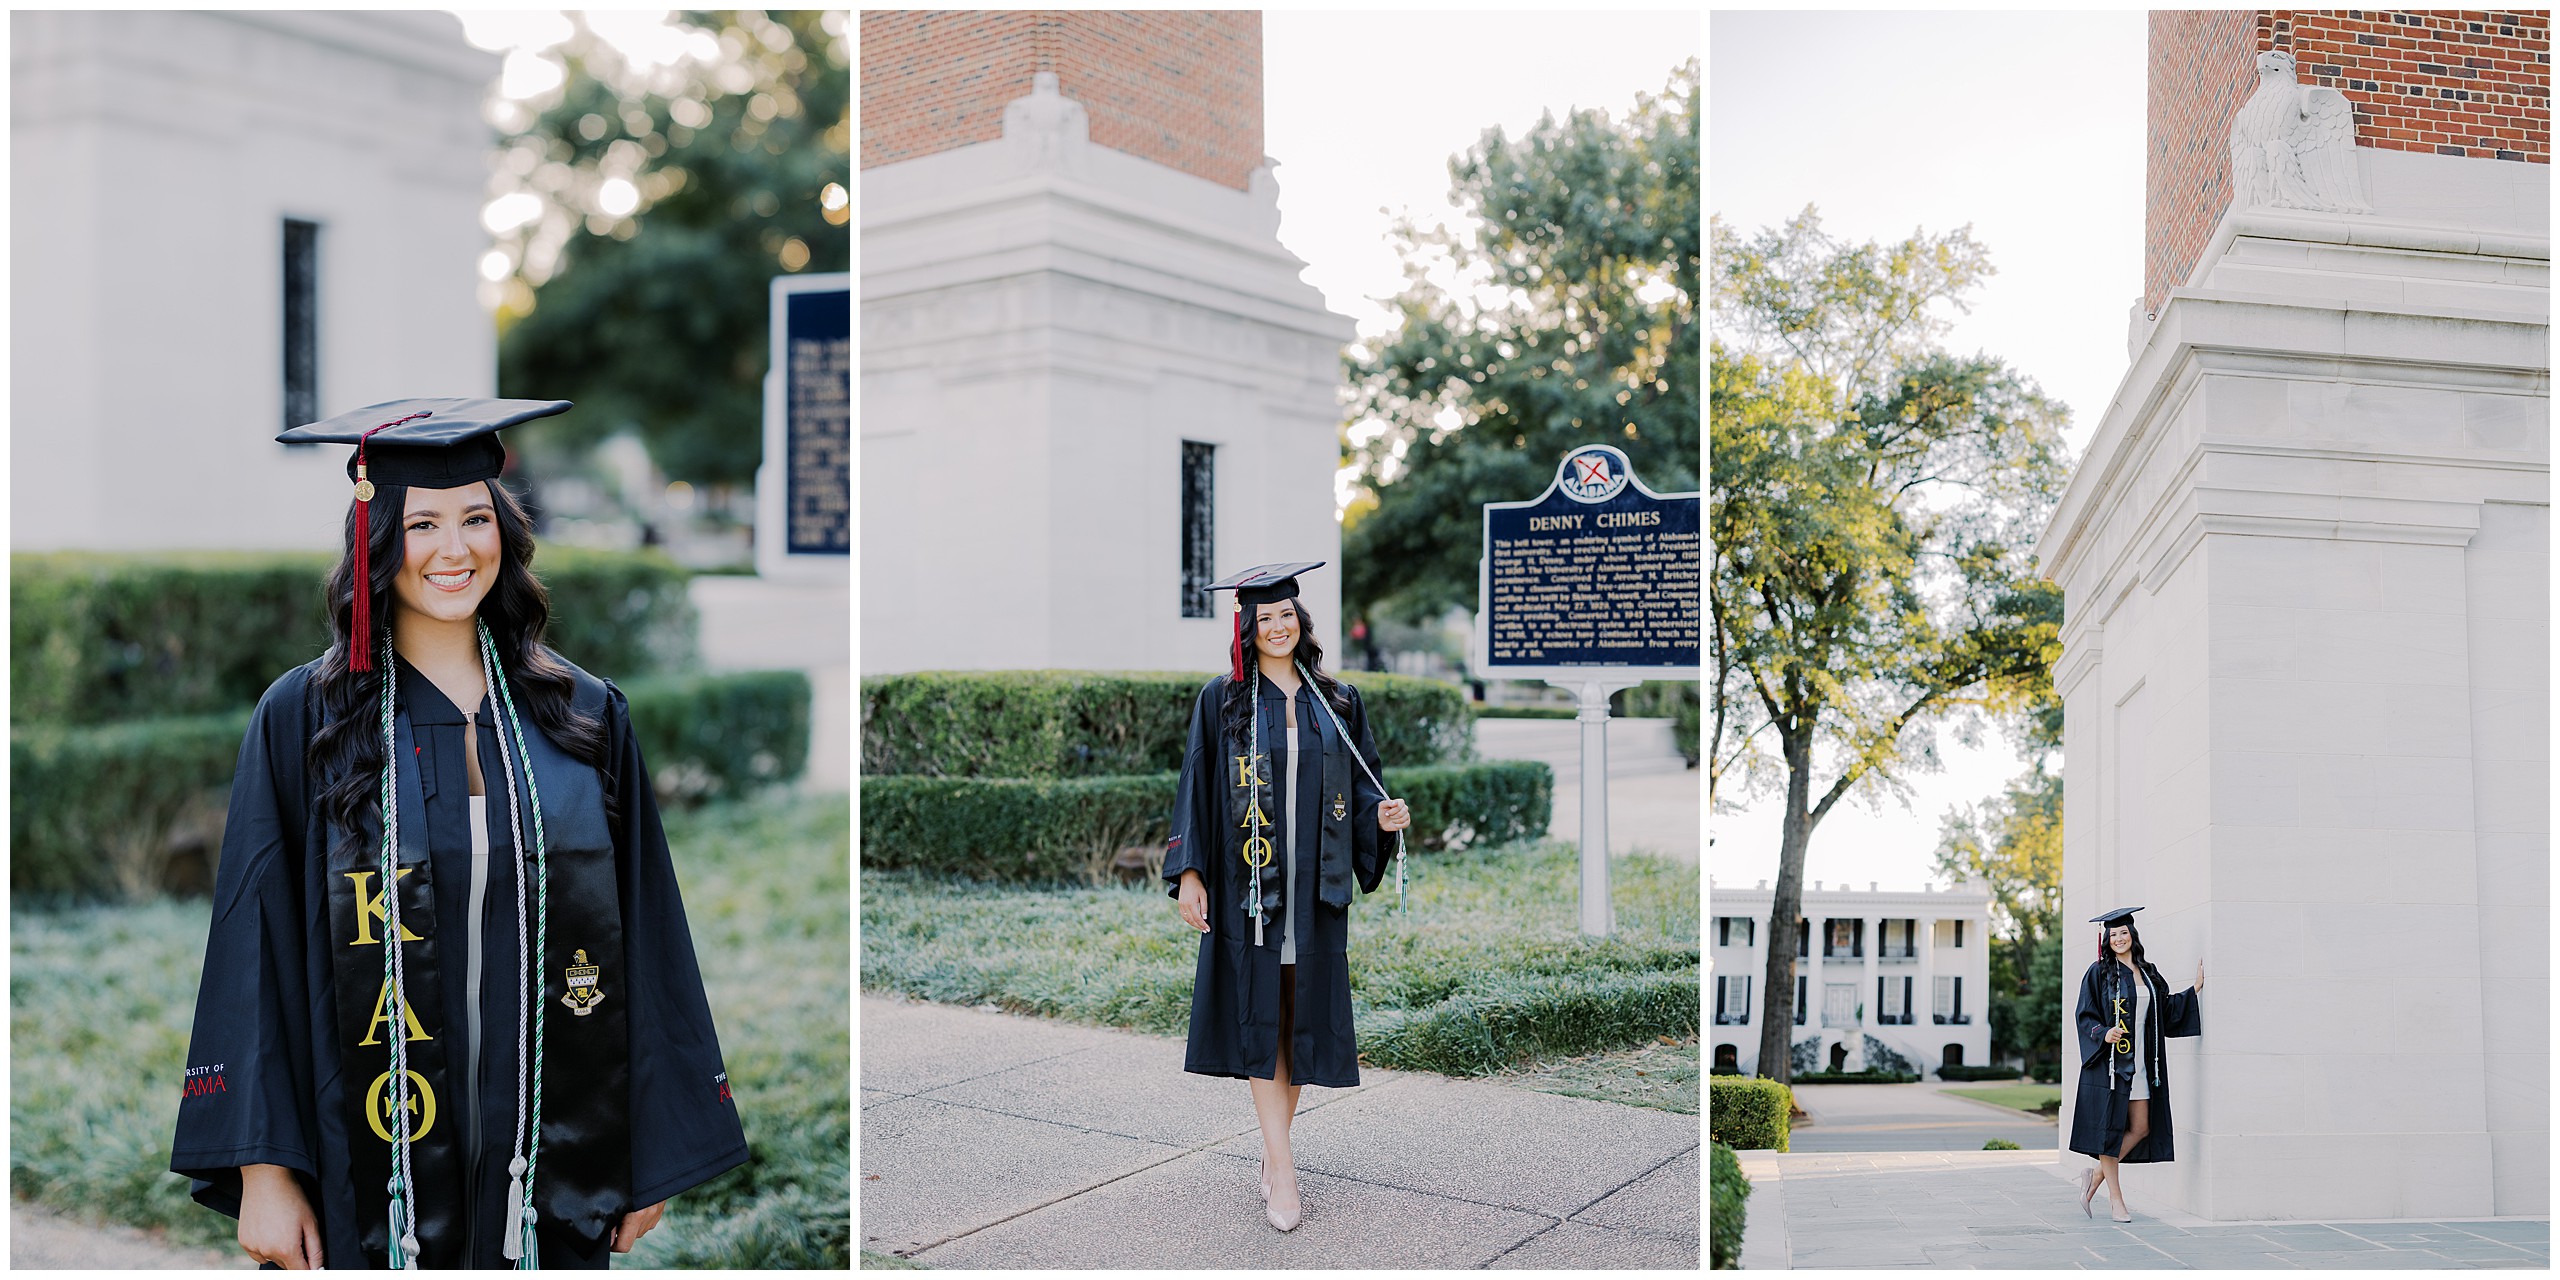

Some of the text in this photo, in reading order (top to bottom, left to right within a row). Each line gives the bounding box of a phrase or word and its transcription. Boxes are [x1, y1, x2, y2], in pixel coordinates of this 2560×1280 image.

[1565, 475, 1624, 498] ALABAMA
[1530, 511, 1660, 531] DENNY CHIMES
[214, 1064, 224, 1072] OF
